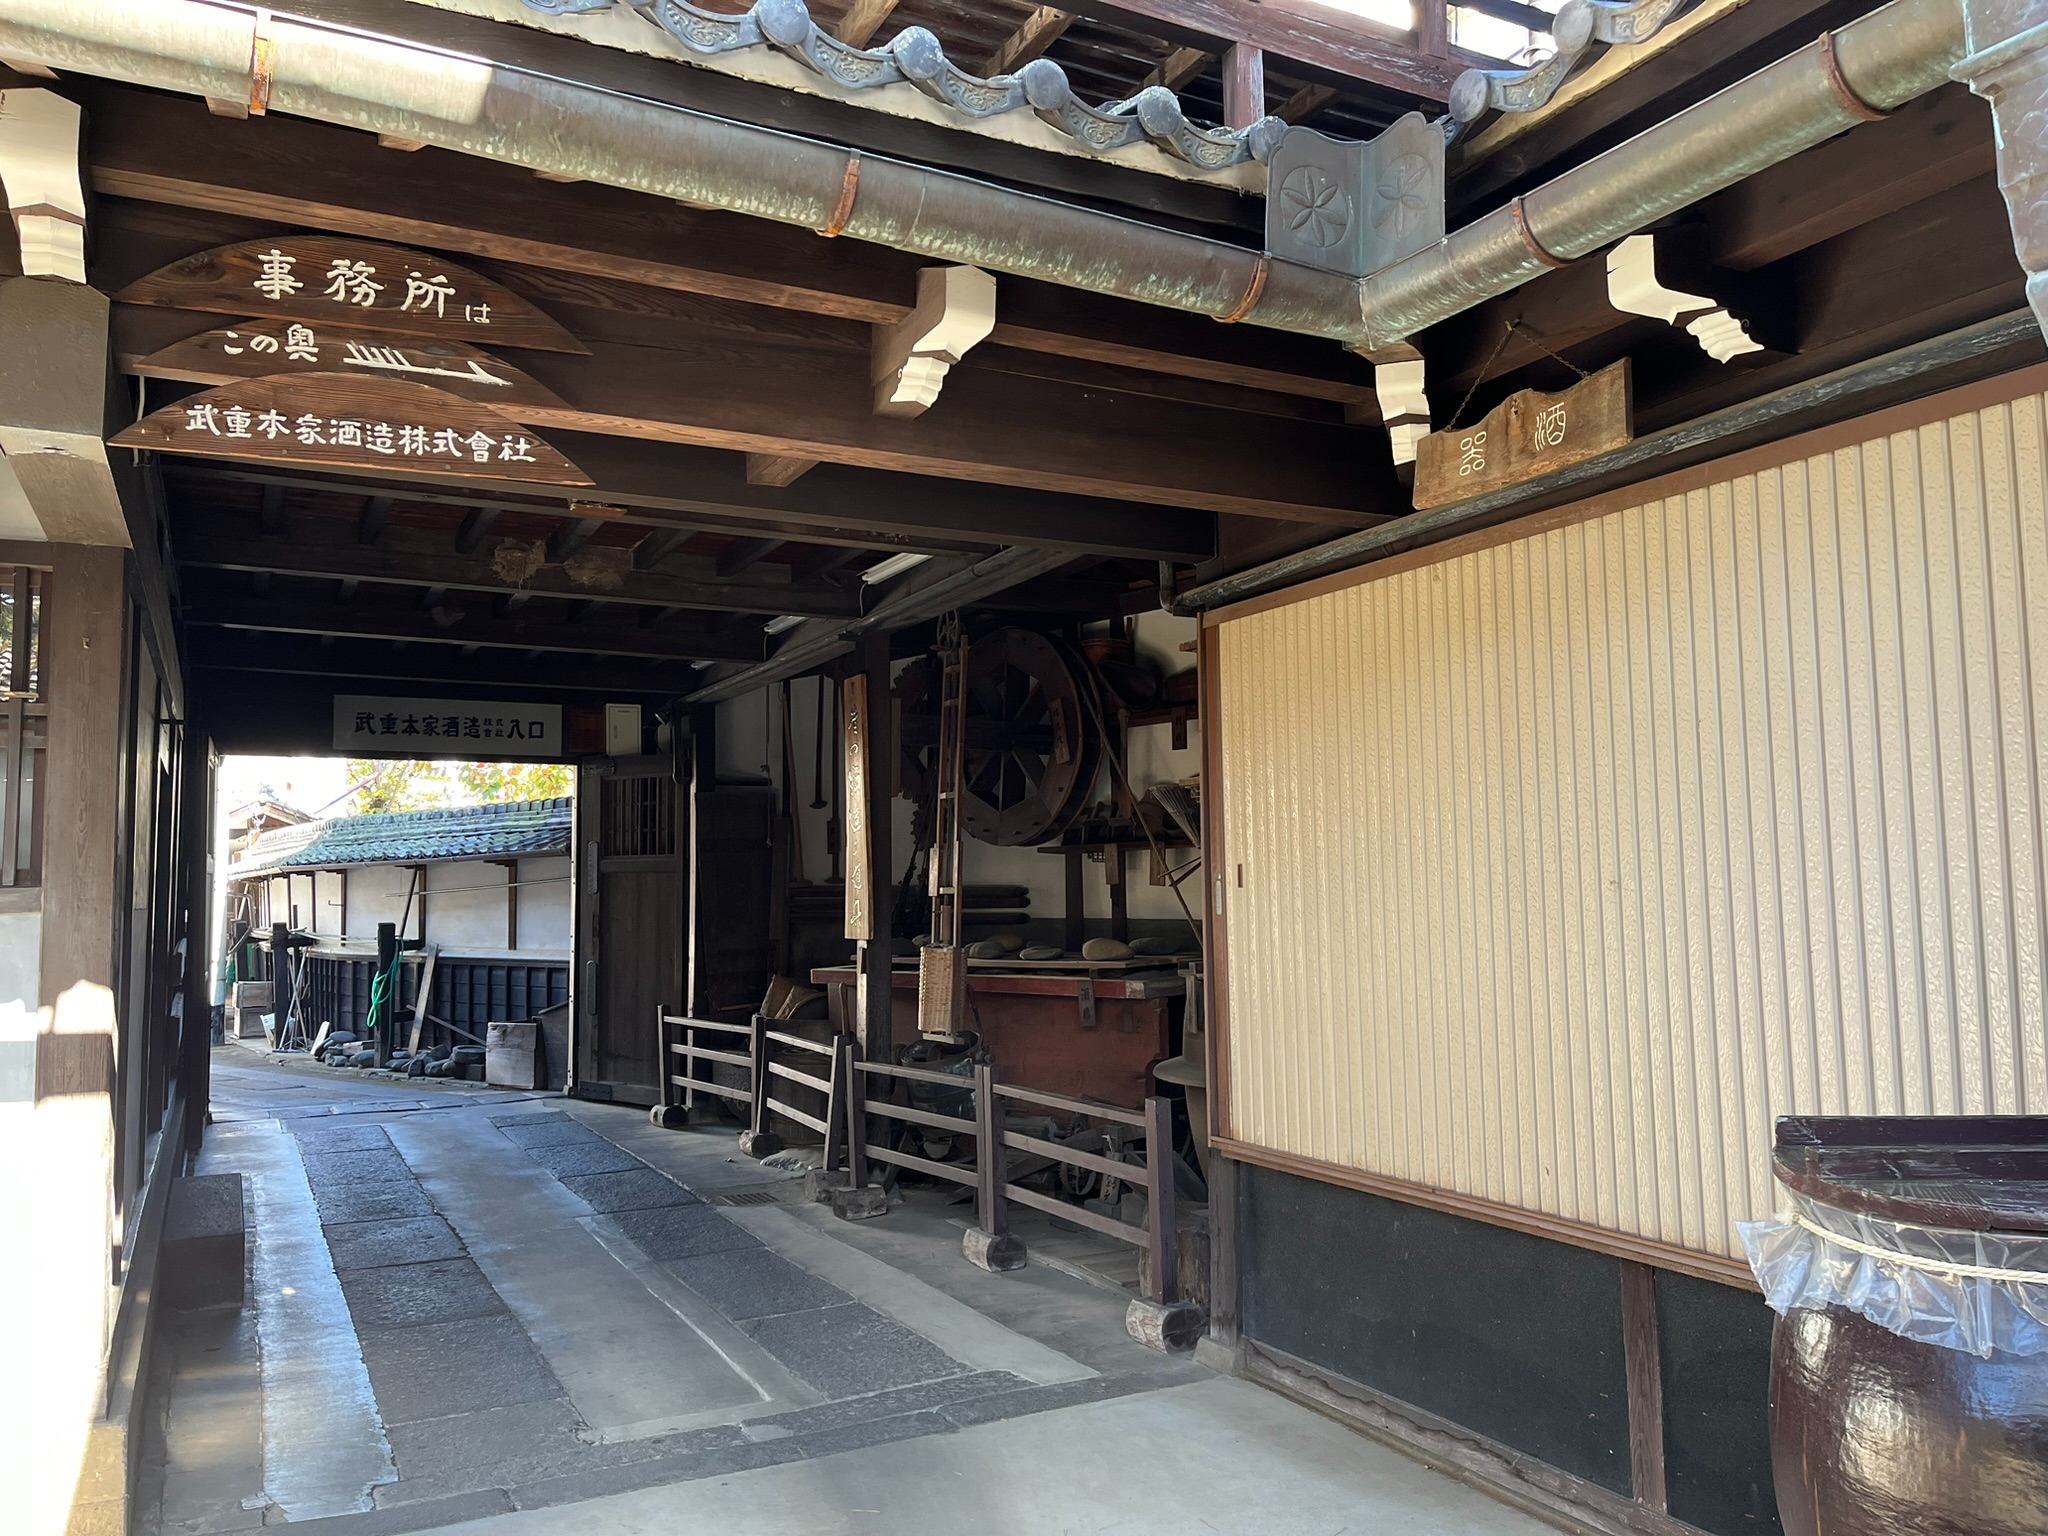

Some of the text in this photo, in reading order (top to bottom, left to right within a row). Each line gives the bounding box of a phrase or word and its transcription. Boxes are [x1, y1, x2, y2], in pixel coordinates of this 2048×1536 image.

[253, 249, 491, 324] 事務所は
[223, 323, 319, 362] この奥
[185, 403, 537, 463] 武重本家酒造株式會社
